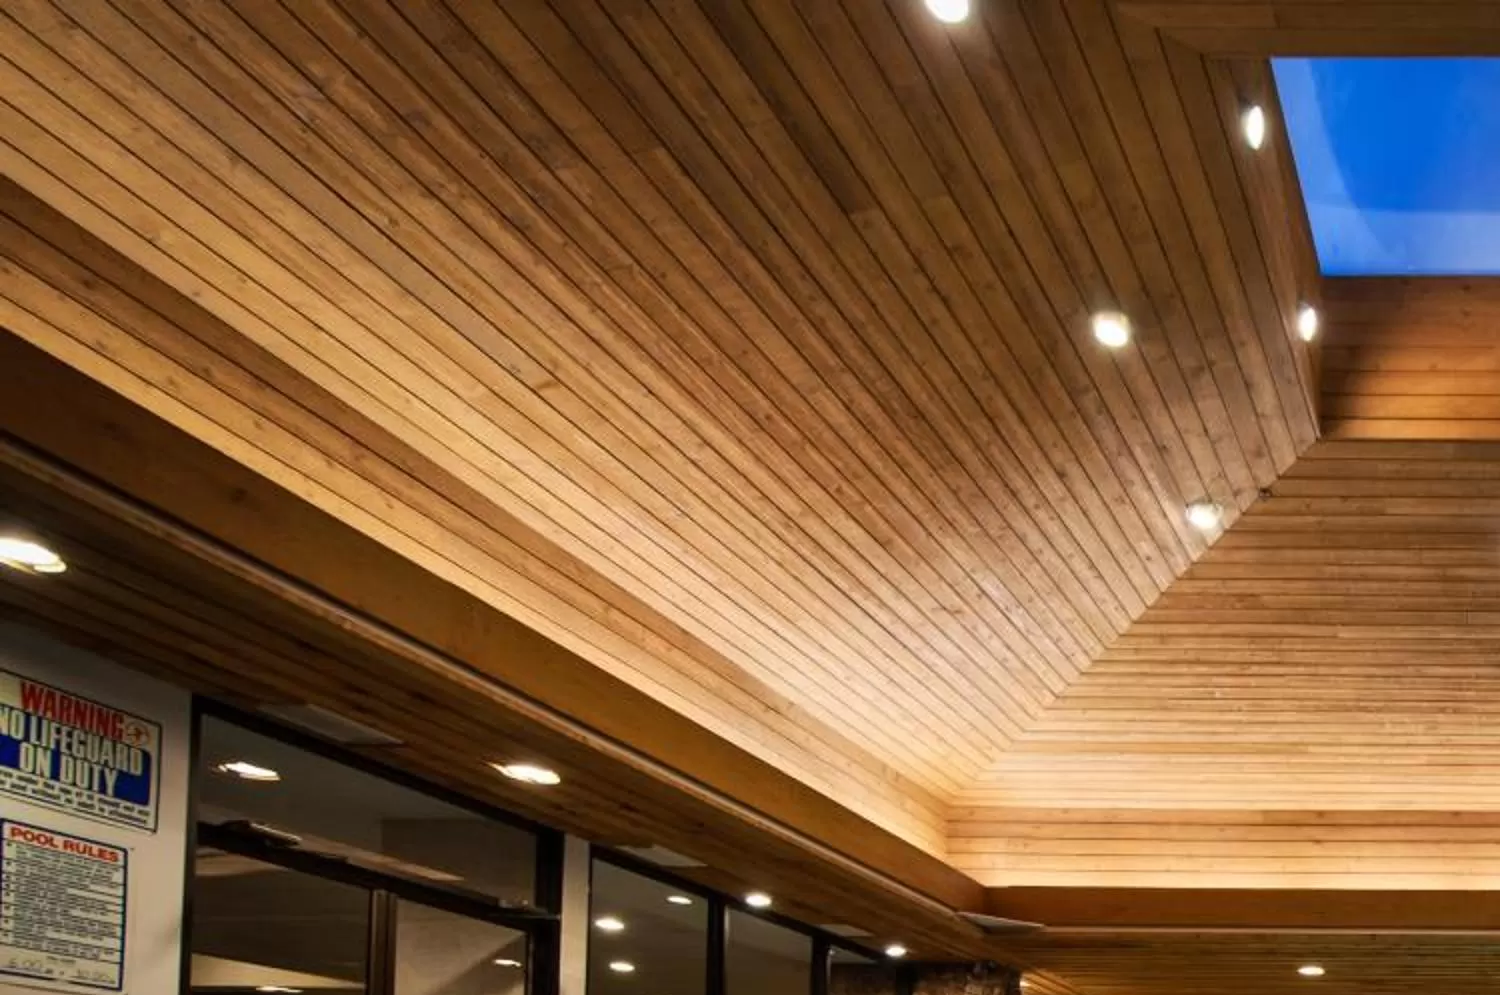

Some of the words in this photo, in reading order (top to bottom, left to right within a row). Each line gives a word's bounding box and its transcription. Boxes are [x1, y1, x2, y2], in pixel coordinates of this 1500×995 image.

[21, 680, 125, 741] WARNING
[19, 741, 52, 780] ON
[60, 753, 118, 797] DUTY
[29, 711, 143, 776] LIFEGUARD
[10, 826, 59, 848] POOL
[63, 839, 119, 863] RULES
